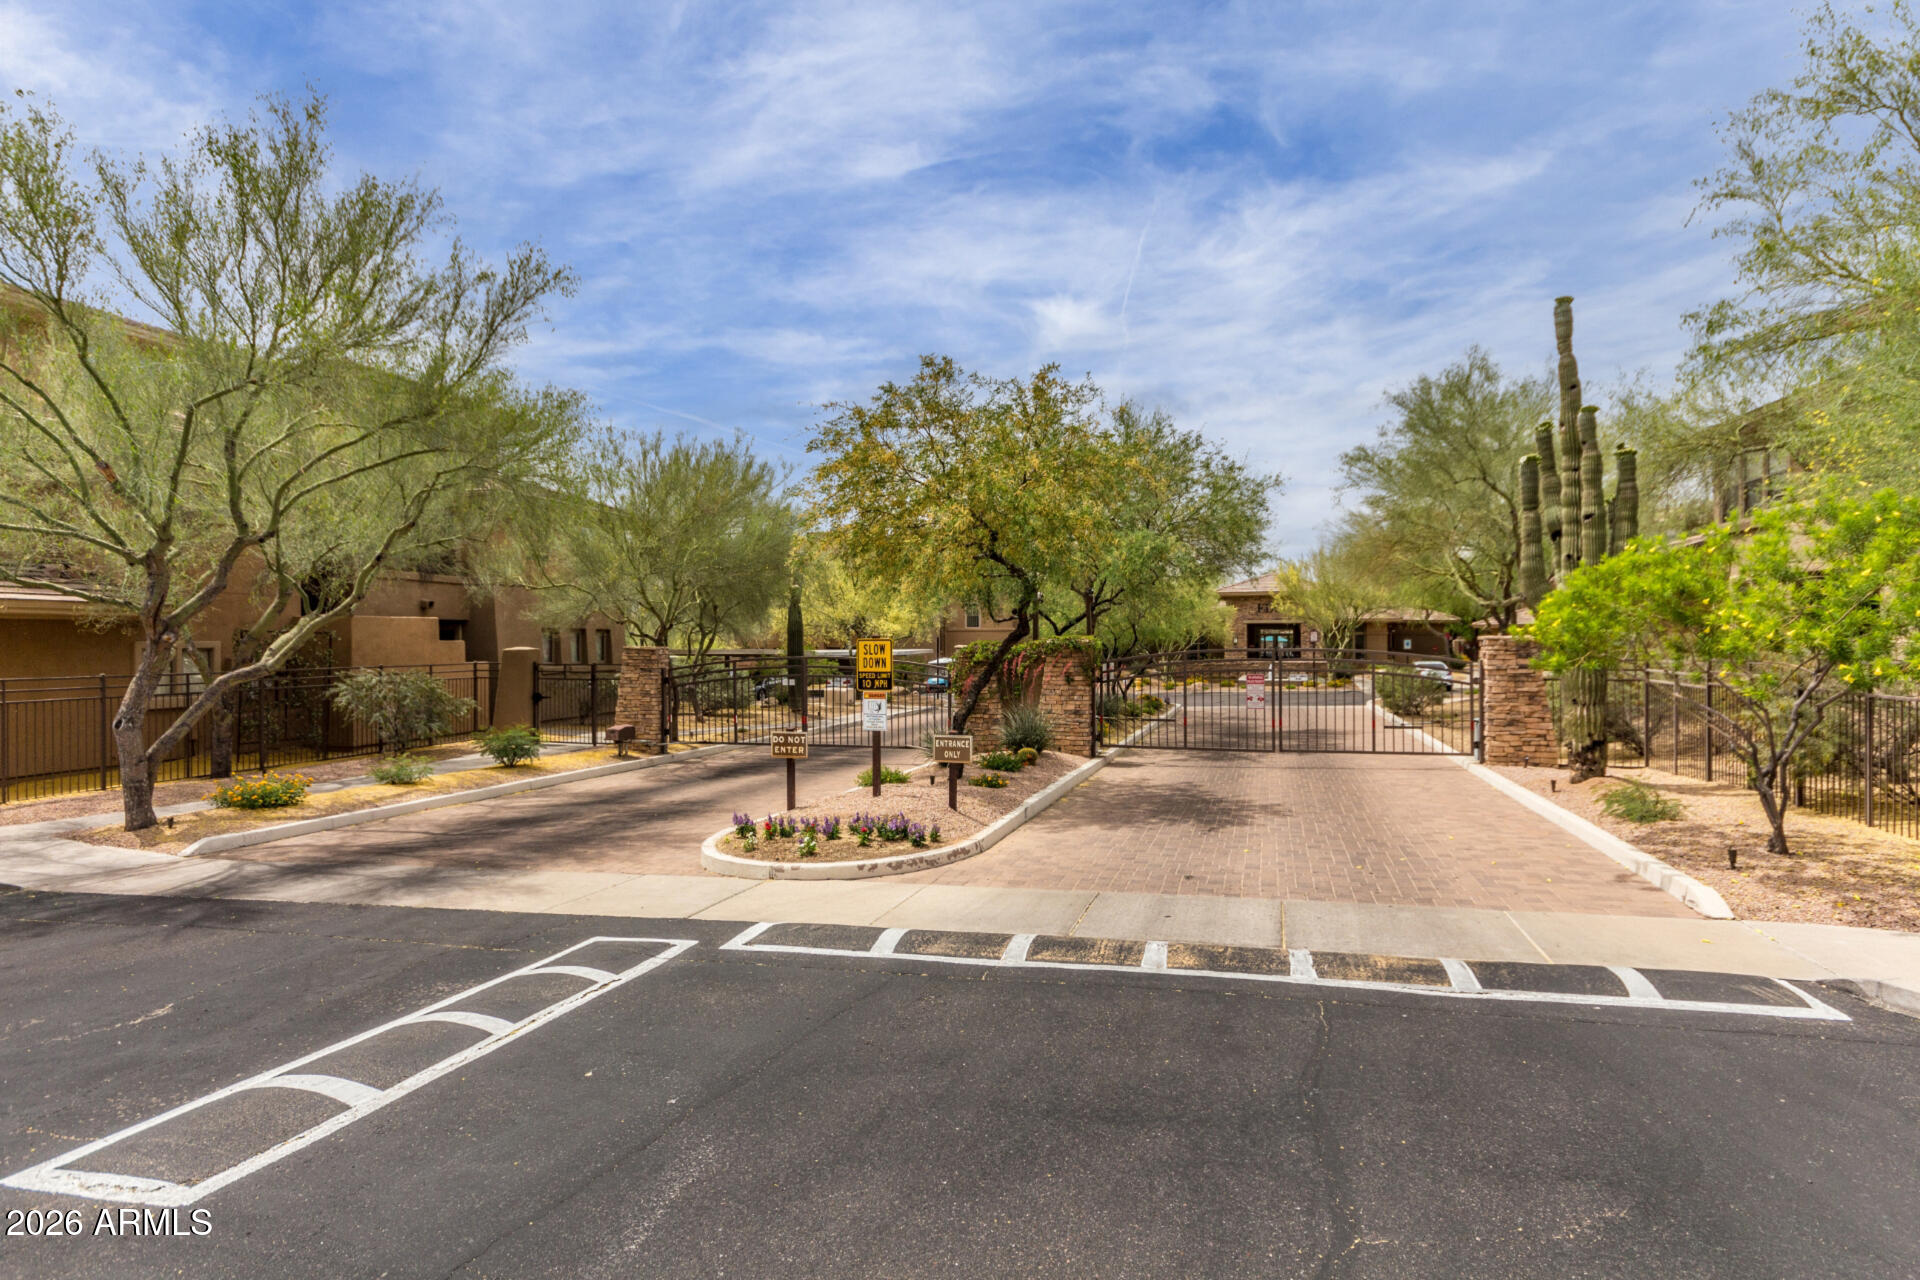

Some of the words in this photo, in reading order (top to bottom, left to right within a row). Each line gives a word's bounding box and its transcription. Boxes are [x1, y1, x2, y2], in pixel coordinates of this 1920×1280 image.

[864, 644, 885, 655] SLOW
[863, 657, 886, 668] DOWN
[863, 680, 871, 688] 10
[874, 680, 888, 688] MPH
[936, 740, 970, 748] ENTRANCE
[944, 750, 960, 758] ONLY
